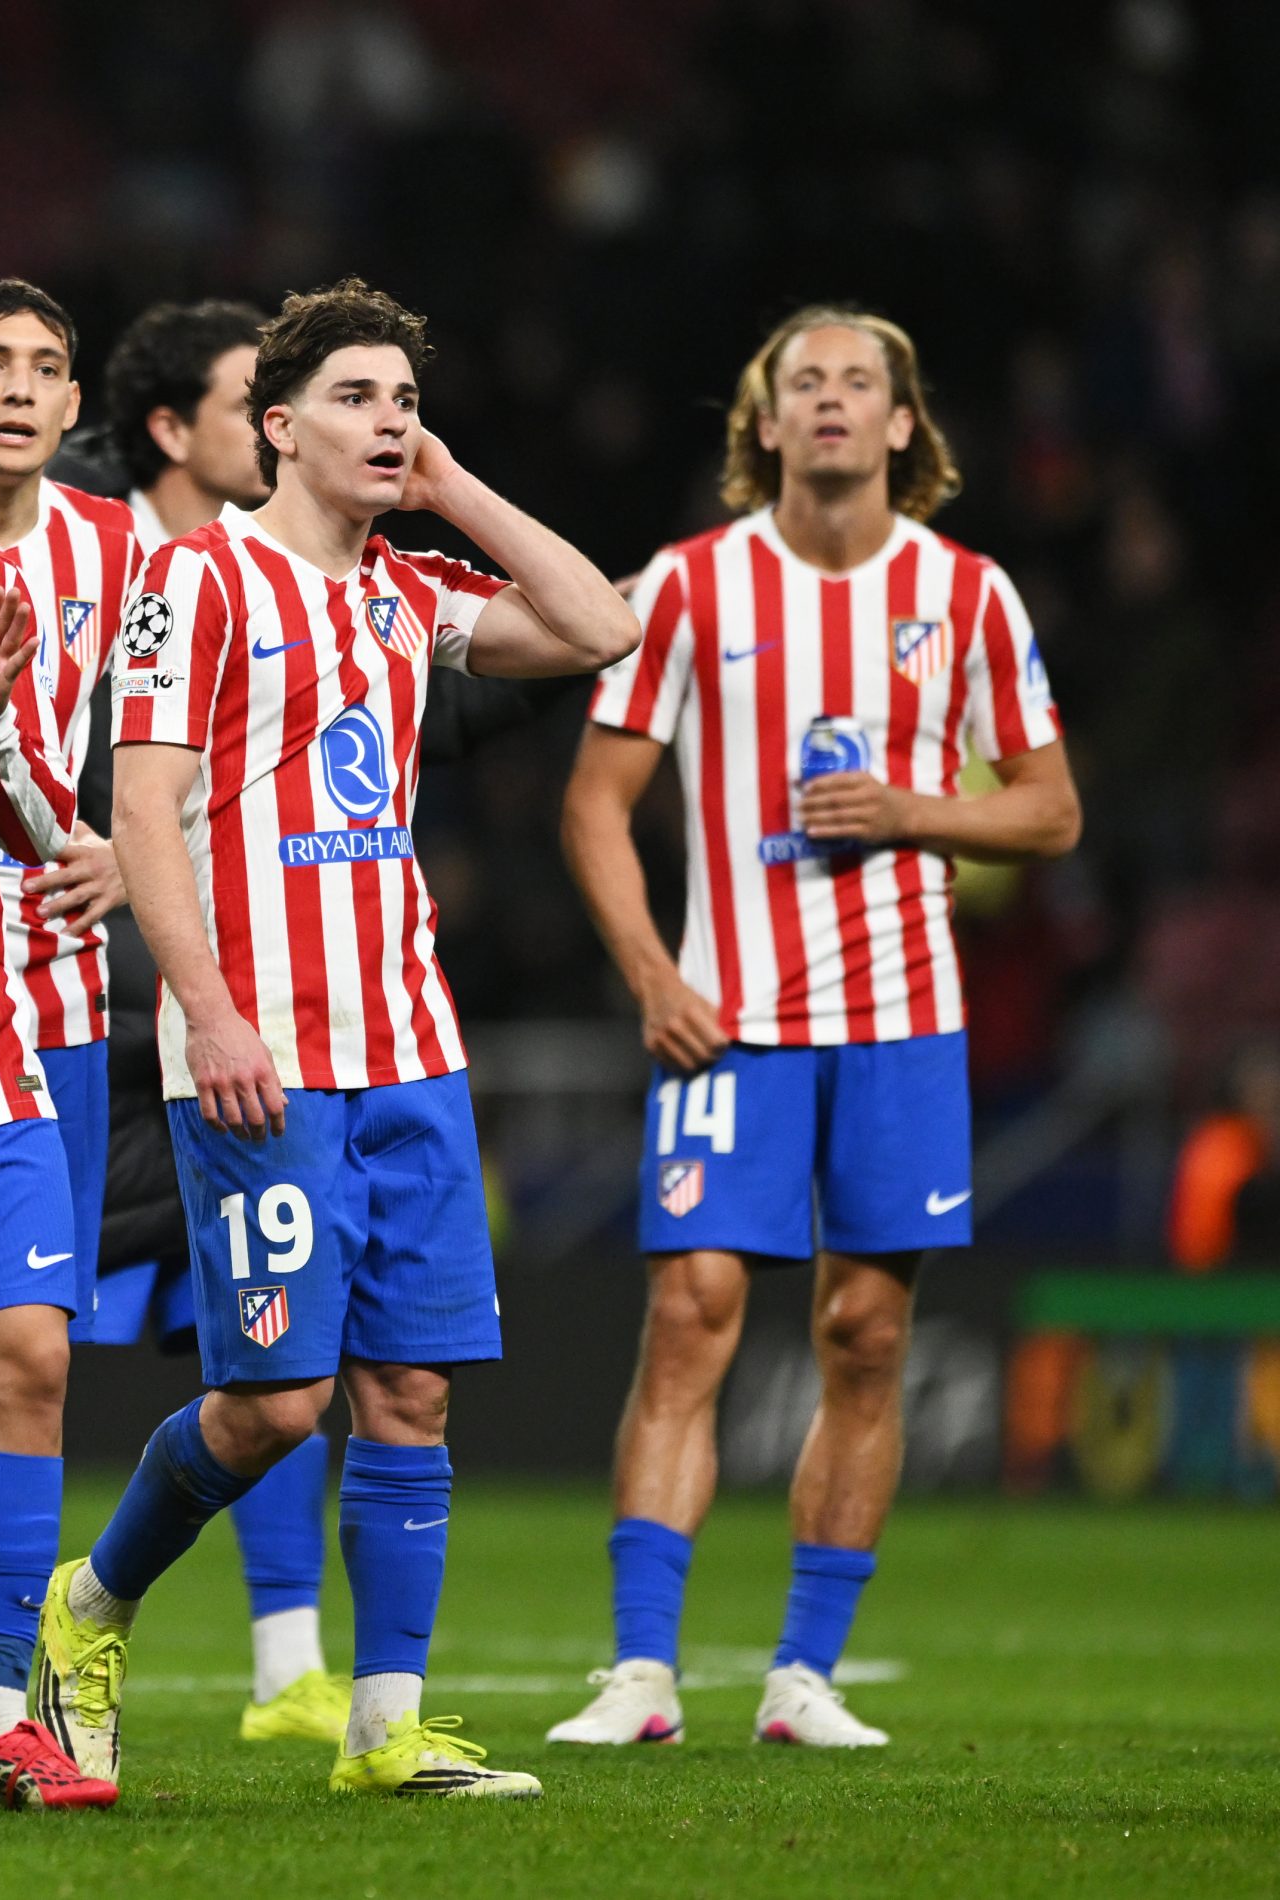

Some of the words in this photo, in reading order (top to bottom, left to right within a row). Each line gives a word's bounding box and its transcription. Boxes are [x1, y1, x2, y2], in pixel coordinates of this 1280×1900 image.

[287, 831, 384, 863] RIYADH
[390, 830, 412, 855] AIR
[656, 1070, 736, 1156] 14
[220, 1183, 313, 1280] 19
